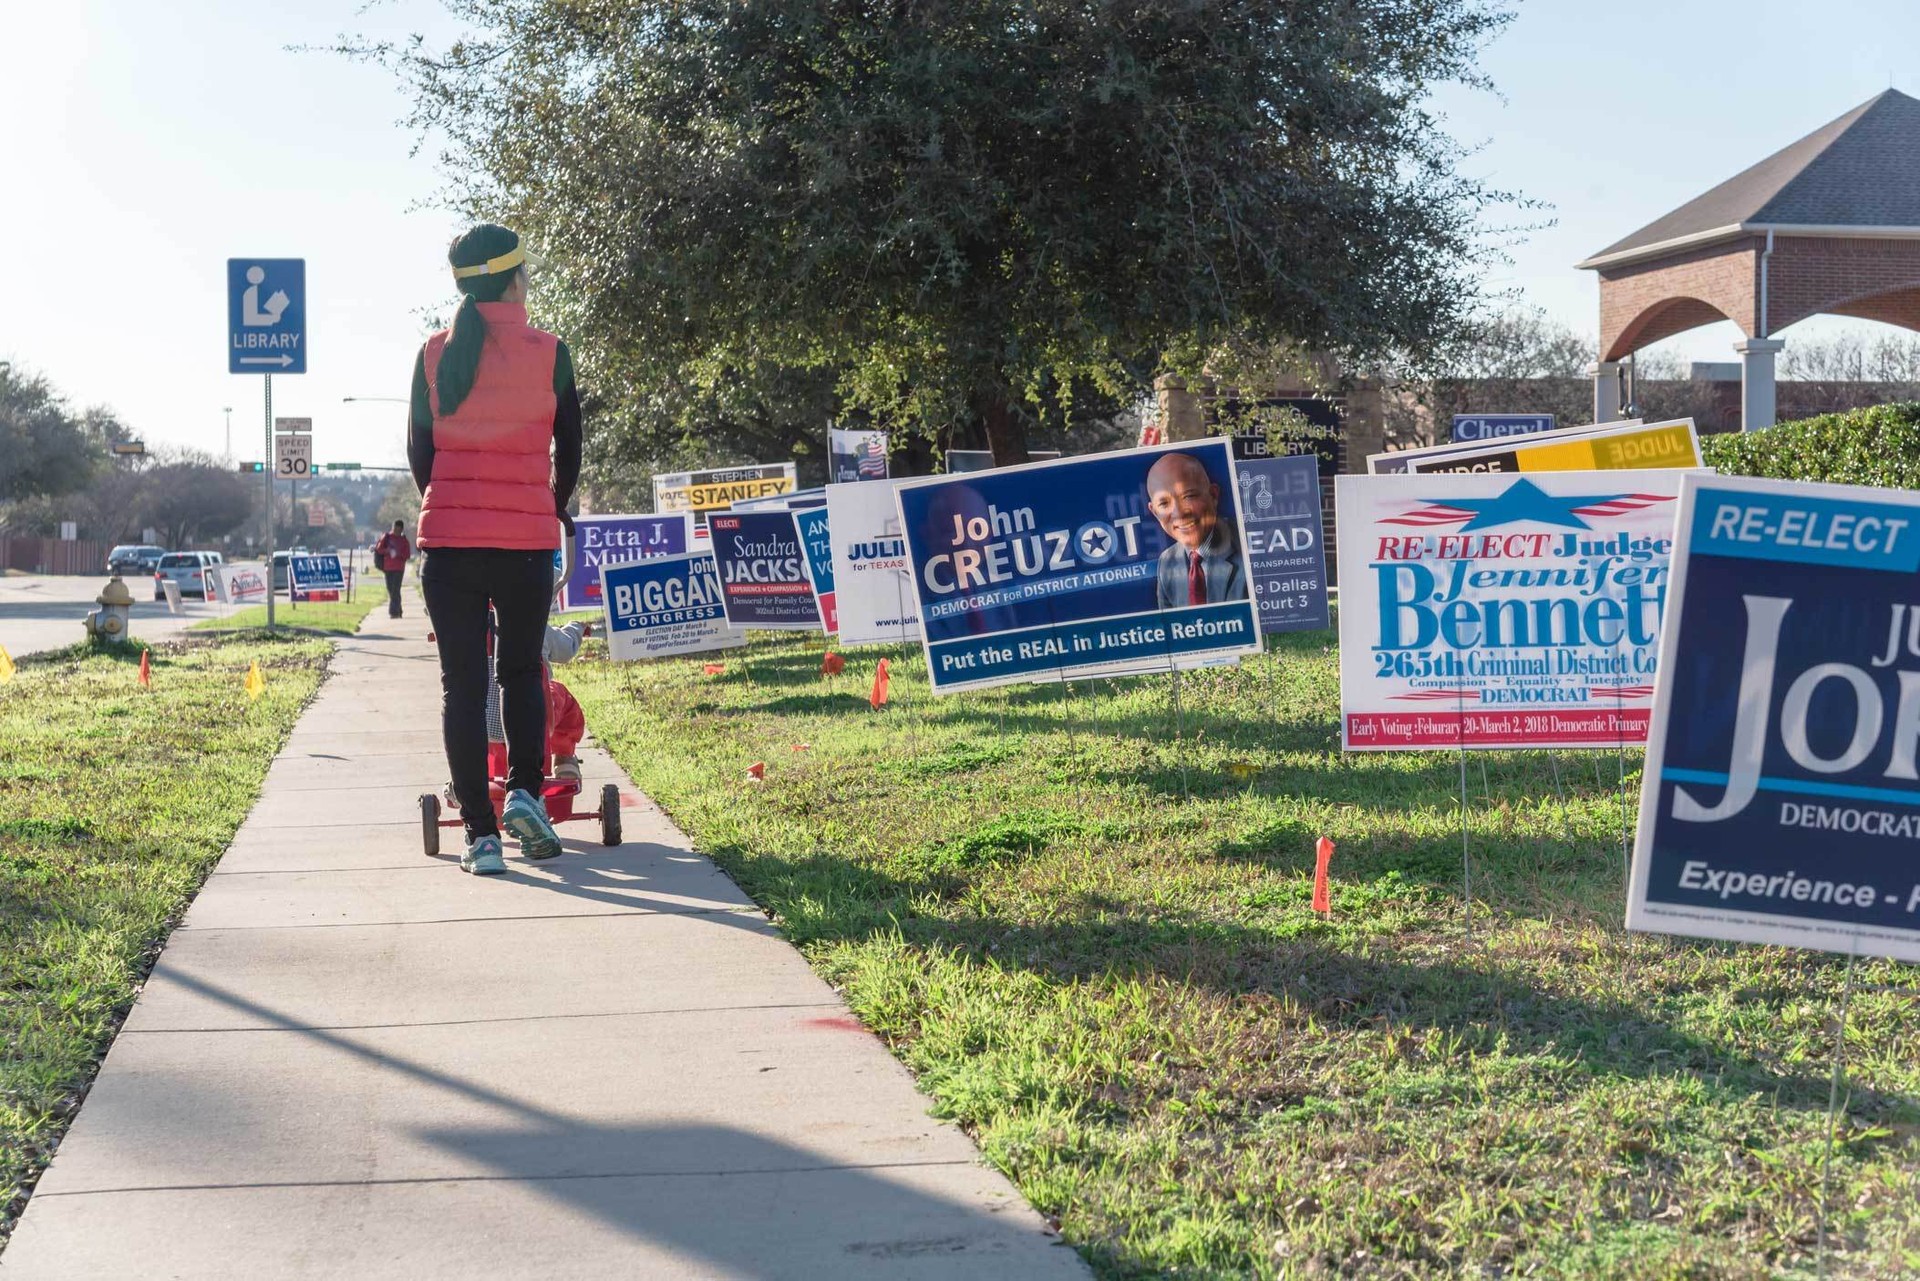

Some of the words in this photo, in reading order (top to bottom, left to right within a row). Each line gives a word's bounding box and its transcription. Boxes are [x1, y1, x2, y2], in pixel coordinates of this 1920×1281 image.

[233, 332, 300, 348] LIBRARY
[1457, 419, 1544, 439] Cheryl
[278, 438, 309, 447] SPEED
[281, 448, 305, 456] LIMIT
[1243, 441, 1308, 456] LIBRY
[280, 458, 307, 475] 30
[711, 468, 763, 483] STEPHEN
[659, 492, 684, 501] VOTE
[692, 481, 786, 506] STANLEY
[716, 519, 738, 529] ELECT!
[951, 504, 1036, 546] John
[1709, 504, 1909, 554] RE-ELECT
[582, 524, 642, 549] Etta
[648, 523, 669, 546] J.
[733, 533, 797, 558] Sandra
[1375, 533, 1552, 560] RE-ELECT
[1553, 531, 1672, 563] Judge
[853, 562, 867, 571] for
[870, 559, 904, 570] TEXAS
[730, 584, 761, 593] EXPERIENCE
[766, 582, 803, 592] COMPASSION
[1269, 578, 1318, 594] Dallas
[1432, 555, 1669, 603] Jennifer
[614, 572, 723, 616] BIGGAN
[931, 591, 1001, 617] DEMOCRAT
[1024, 576, 1080, 599] DISTRICT
[1083, 563, 1148, 587] ATTORNEY
[732, 597, 762, 606] Democrat
[763, 596, 772, 606] for
[774, 595, 797, 606] Family
[1299, 595, 1308, 608] 3
[628, 606, 716, 628] CONGRESS
[776, 606, 800, 616] District
[632, 635, 649, 646] EARLY
[649, 633, 669, 644] VOTING
[670, 631, 681, 641] Feb
[696, 627, 714, 638] March
[645, 624, 672, 636] ELECTION
[672, 623, 684, 633] DAY
[685, 622, 702, 631] March
[941, 652, 975, 672] Put
[979, 646, 1013, 666] the
[1017, 637, 1070, 659] REAL
[1073, 633, 1092, 651] in
[1098, 623, 1166, 650] Justice
[1171, 616, 1244, 641] Reform
[1374, 650, 1465, 678] 265th
[1467, 648, 1550, 678] Criminal
[1555, 647, 1628, 676] District
[1408, 677, 1487, 690] Compassion
[1506, 675, 1562, 687] Equality
[1584, 674, 1643, 686] Integrity
[1480, 686, 1591, 704] DEMOCRAT
[1351, 717, 1379, 741] Early
[1380, 717, 1412, 741] Voting
[1524, 714, 1549, 735] 2018
[1550, 713, 1606, 734] Democratic
[1607, 712, 1649, 738] Primary
[1780, 802, 1920, 840] DEMOCRAT
[1678, 859, 1876, 908] Experience
